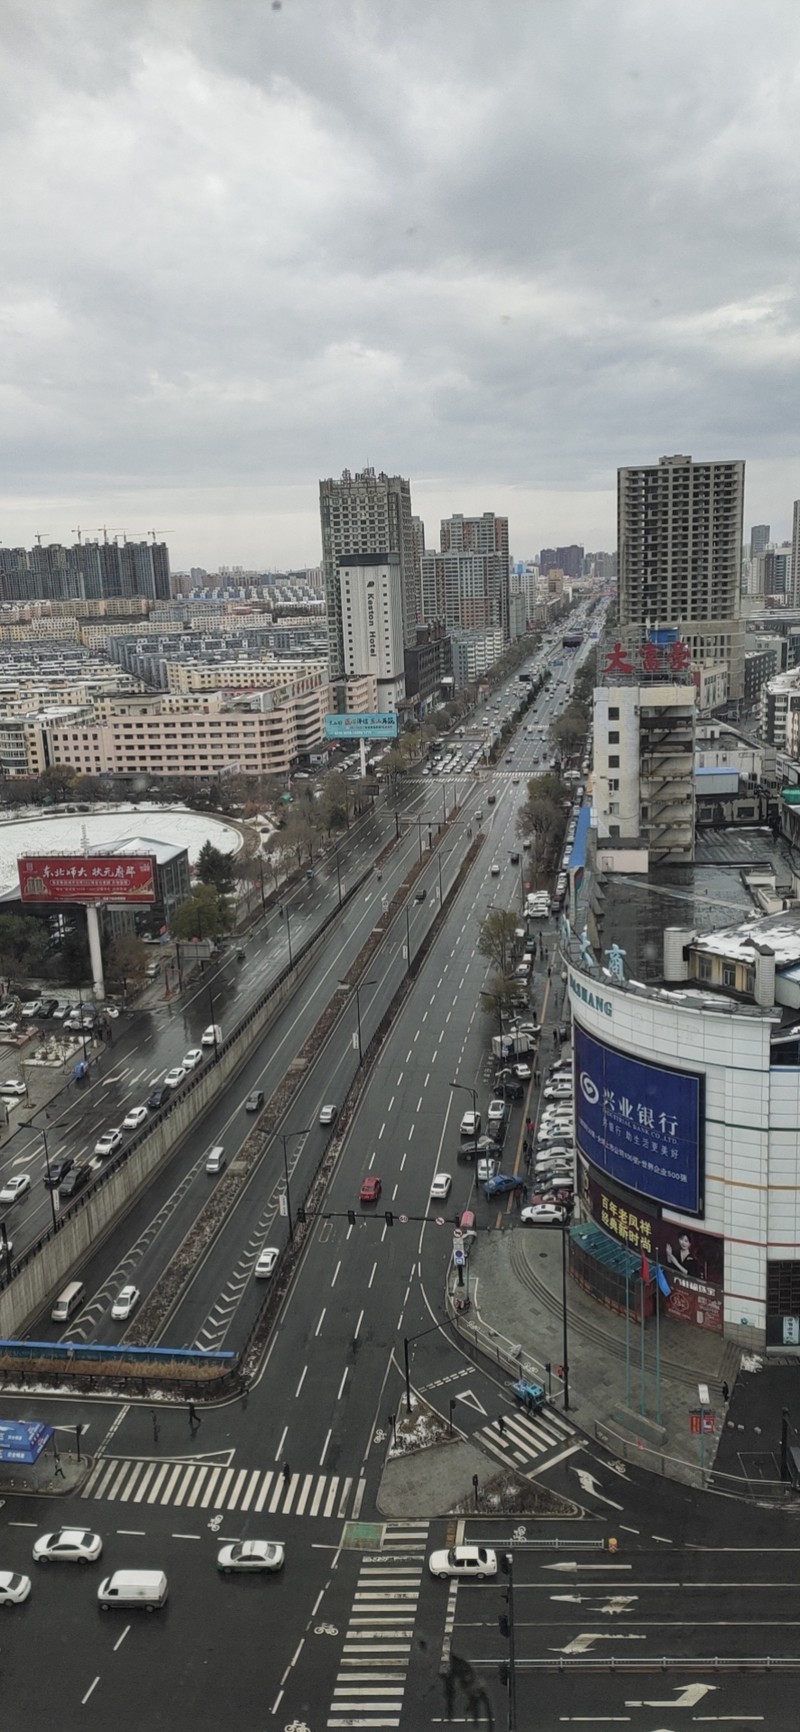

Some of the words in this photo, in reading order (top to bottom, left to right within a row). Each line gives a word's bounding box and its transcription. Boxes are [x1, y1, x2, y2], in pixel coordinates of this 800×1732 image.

[369, 631, 377, 657] Hotel
[601, 642, 690, 674] 大富豪
[602, 1087, 678, 1136] 兴业银行
[601, 1193, 652, 1237] 百年老凤祥
[601, 1210, 652, 1253] 经典新时尚
